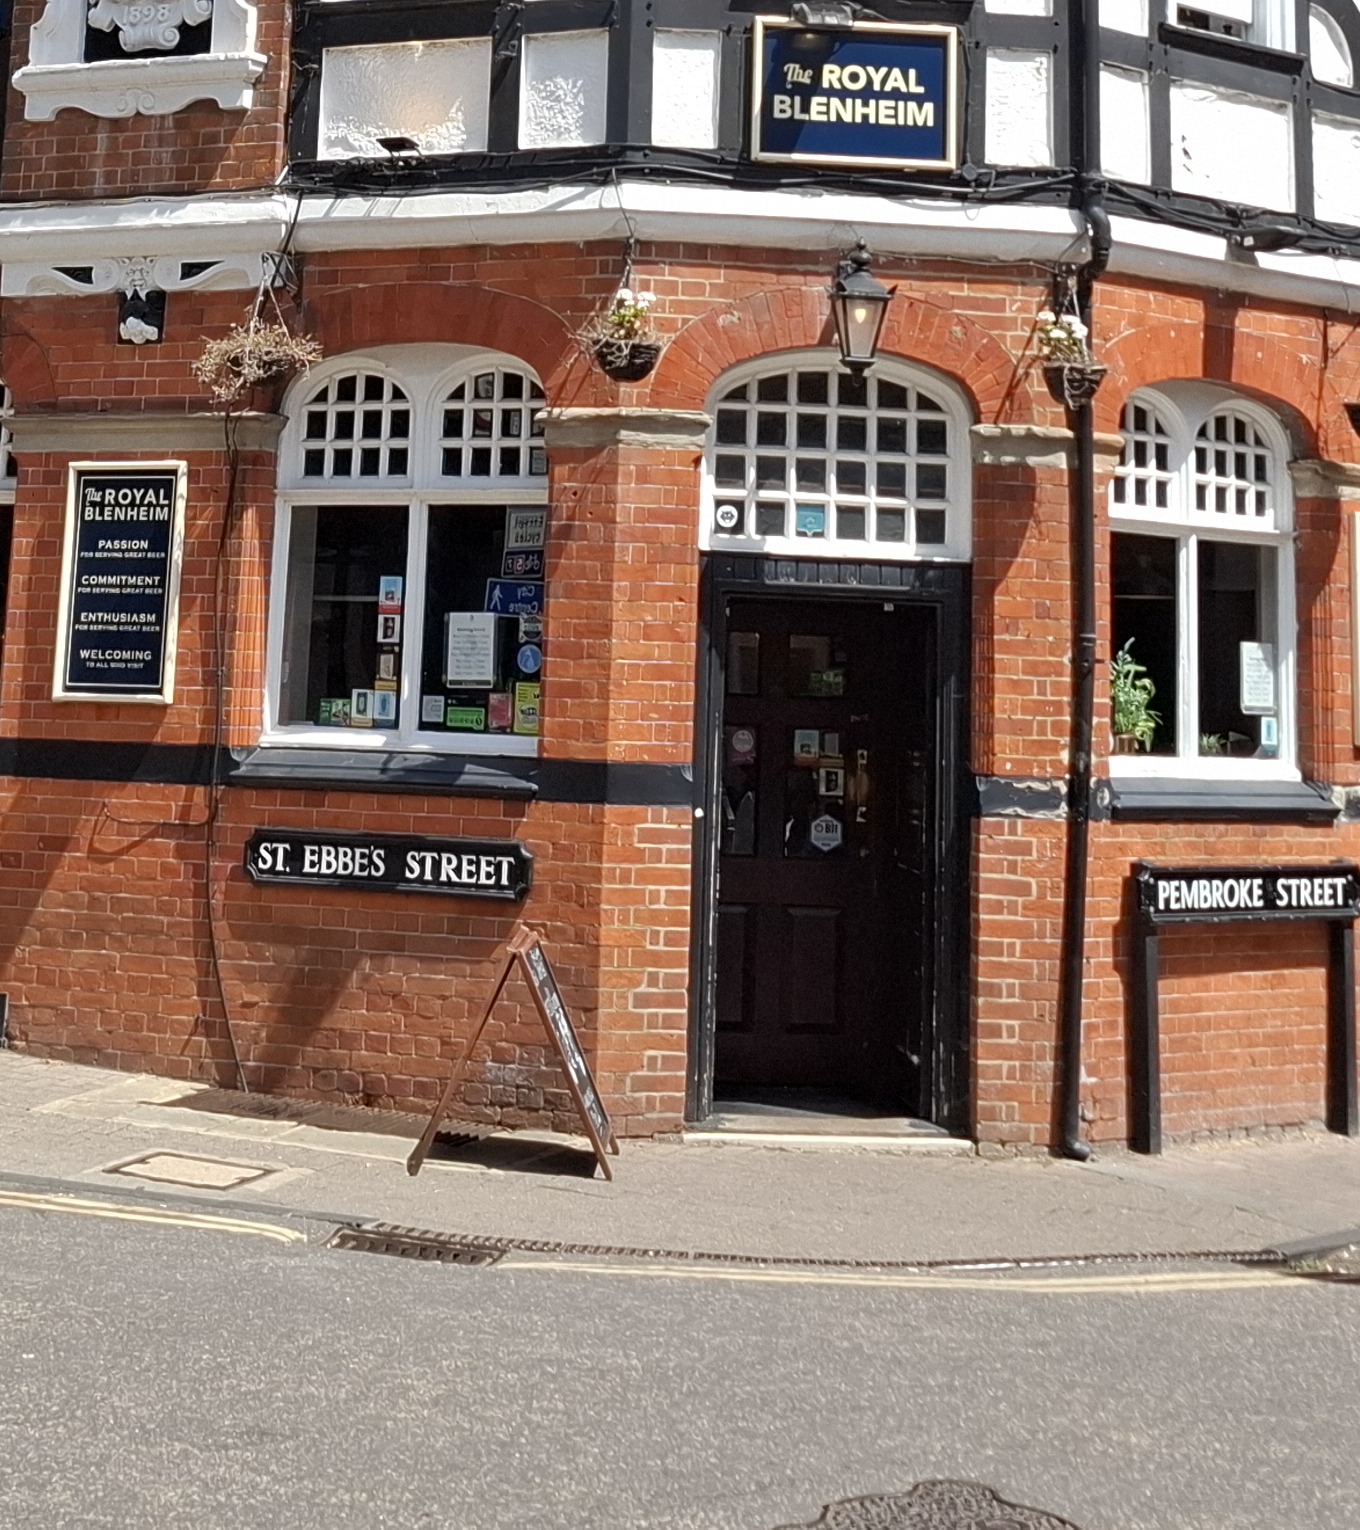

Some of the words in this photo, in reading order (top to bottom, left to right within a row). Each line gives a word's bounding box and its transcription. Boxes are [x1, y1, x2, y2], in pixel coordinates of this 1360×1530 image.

[123, 5, 171, 25] 1898
[783, 62, 813, 89] The
[822, 63, 925, 94] ROYAL
[773, 94, 935, 127] BLENHEIM
[85, 487, 102, 506] The
[104, 488, 169, 505] ROYAL
[84, 506, 169, 521] BLENHEIM
[98, 539, 149, 550] PASSION
[81, 575, 161, 586] COMMITMENT
[80, 612, 157, 623] ENTHUSIASM
[79, 649, 152, 661] WELCOMING
[257, 842, 290, 873] ST.
[302, 844, 386, 877] EBBE'S
[405, 850, 516, 886] STREET
[1157, 878, 1264, 911] PEMBROKE
[1275, 877, 1347, 908] STREET
